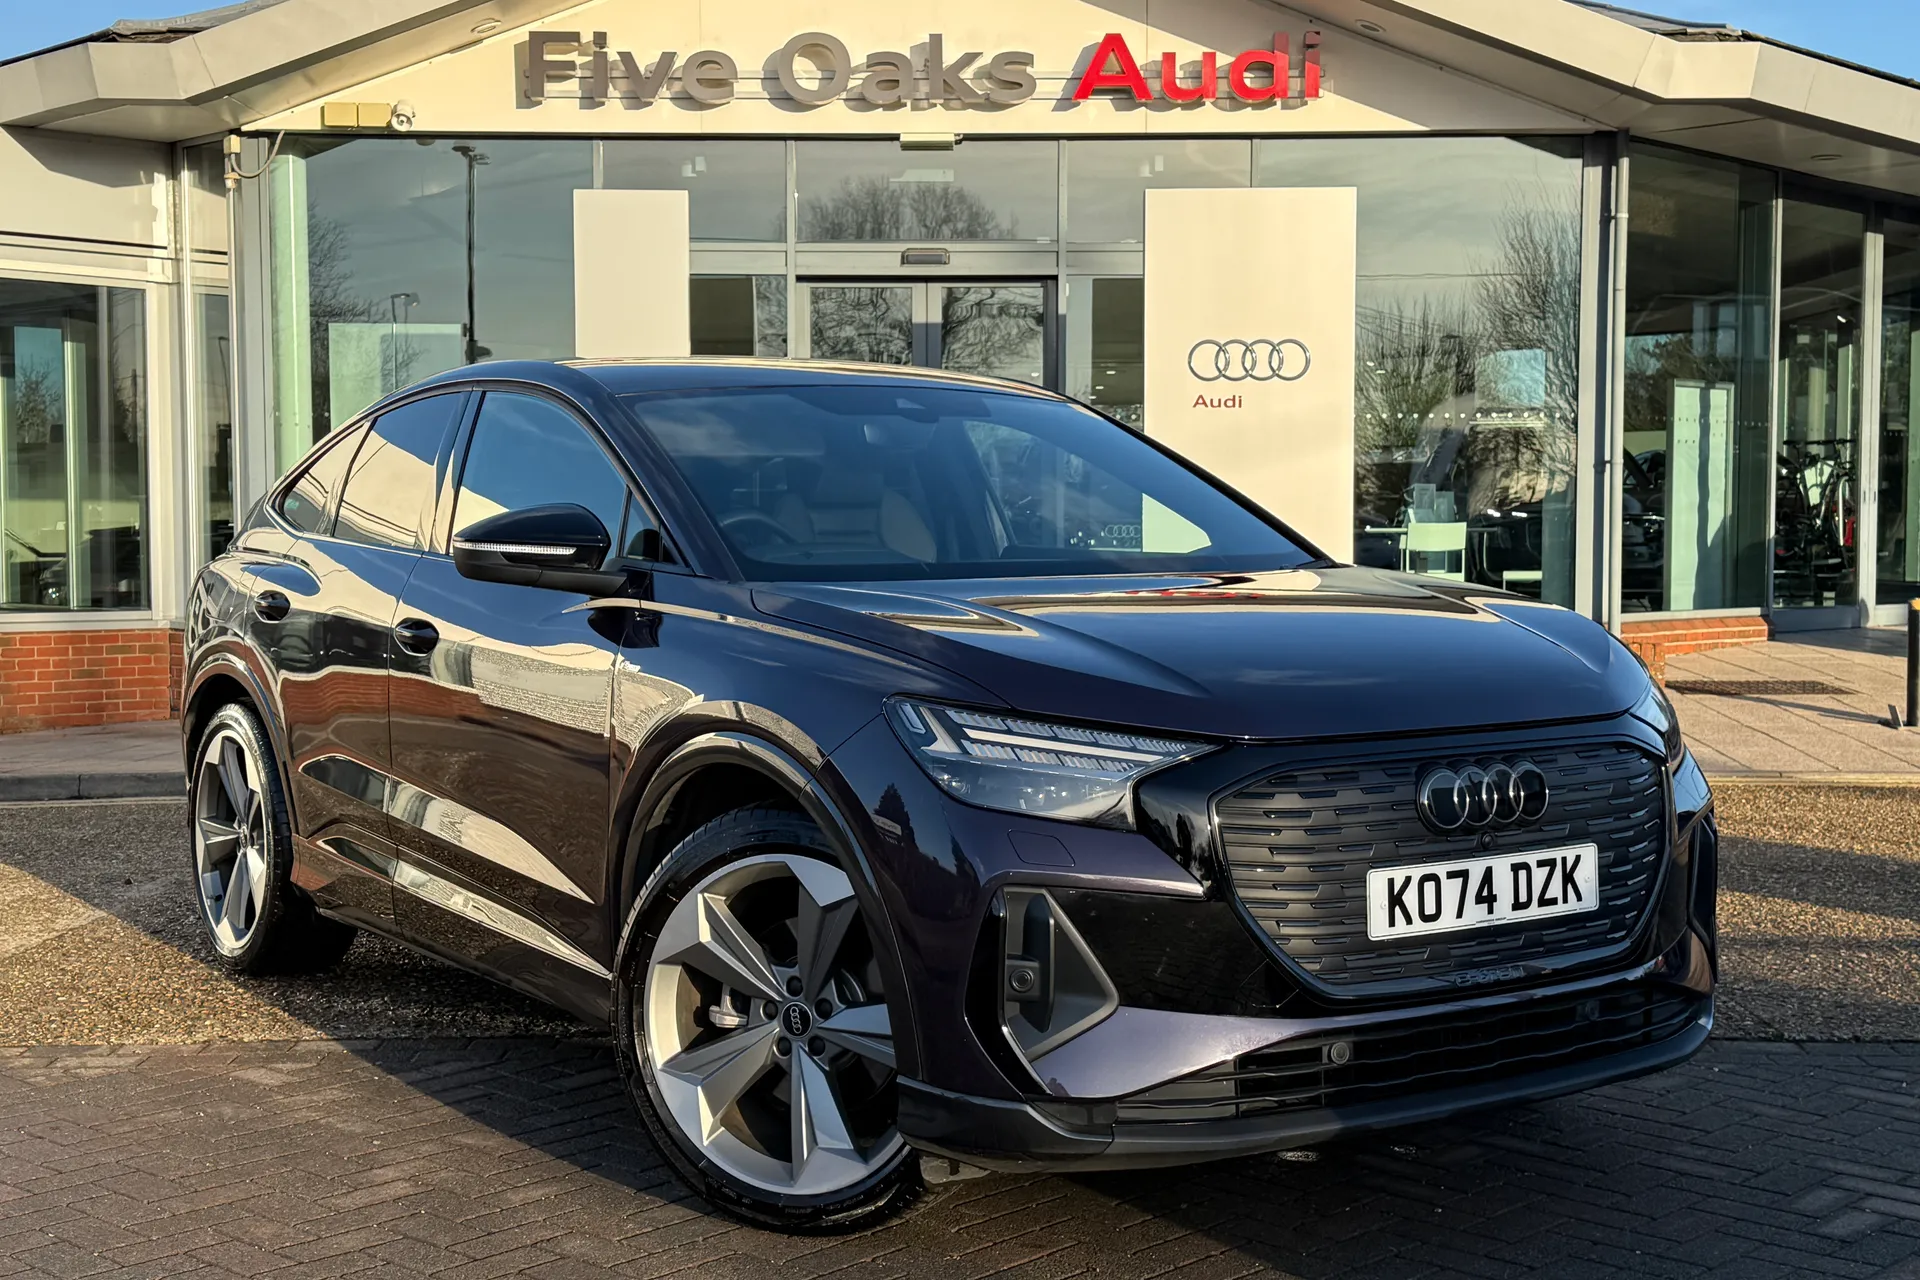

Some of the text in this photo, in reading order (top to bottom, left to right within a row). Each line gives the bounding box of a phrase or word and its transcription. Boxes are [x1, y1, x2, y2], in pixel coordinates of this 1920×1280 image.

[528, 31, 1321, 105] Five Oaks Audi
[1192, 394, 1243, 409] Audi
[1387, 854, 1583, 928] KO74 DZK
